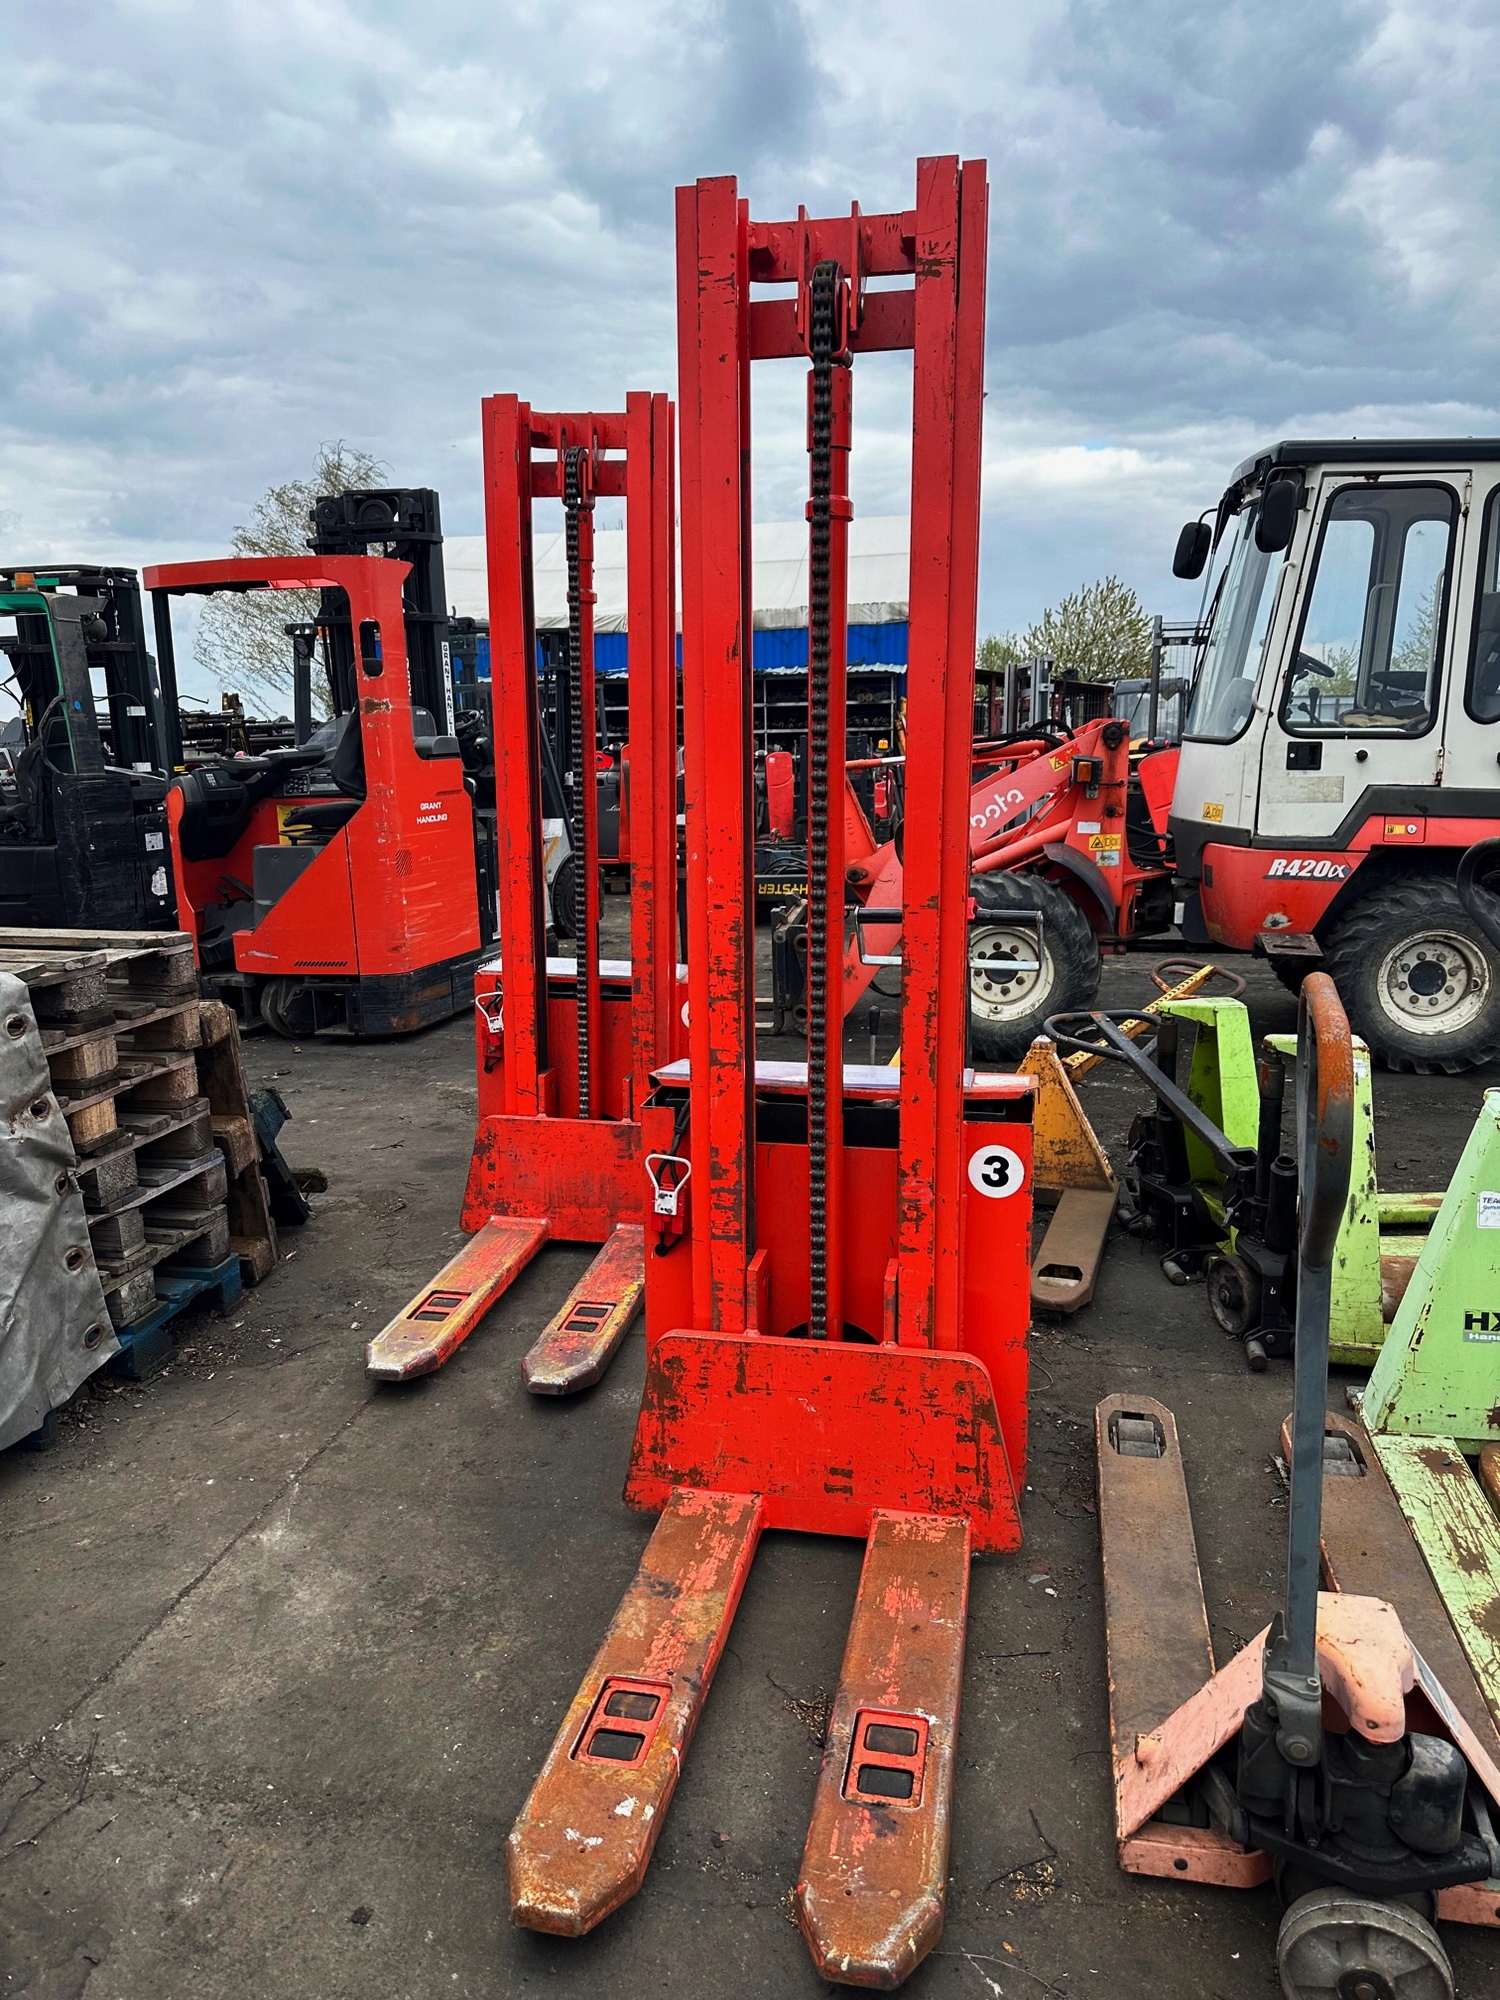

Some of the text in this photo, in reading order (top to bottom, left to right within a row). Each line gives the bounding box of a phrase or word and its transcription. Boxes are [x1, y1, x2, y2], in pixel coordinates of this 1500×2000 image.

[420, 802, 442, 811] GRANT
[970, 789, 1024, 828] bota
[416, 813, 448, 824] HANDLING
[758, 883, 808, 895] HYSTER
[981, 1155, 1010, 1188] 3
[1468, 1333, 1500, 1341] Han
